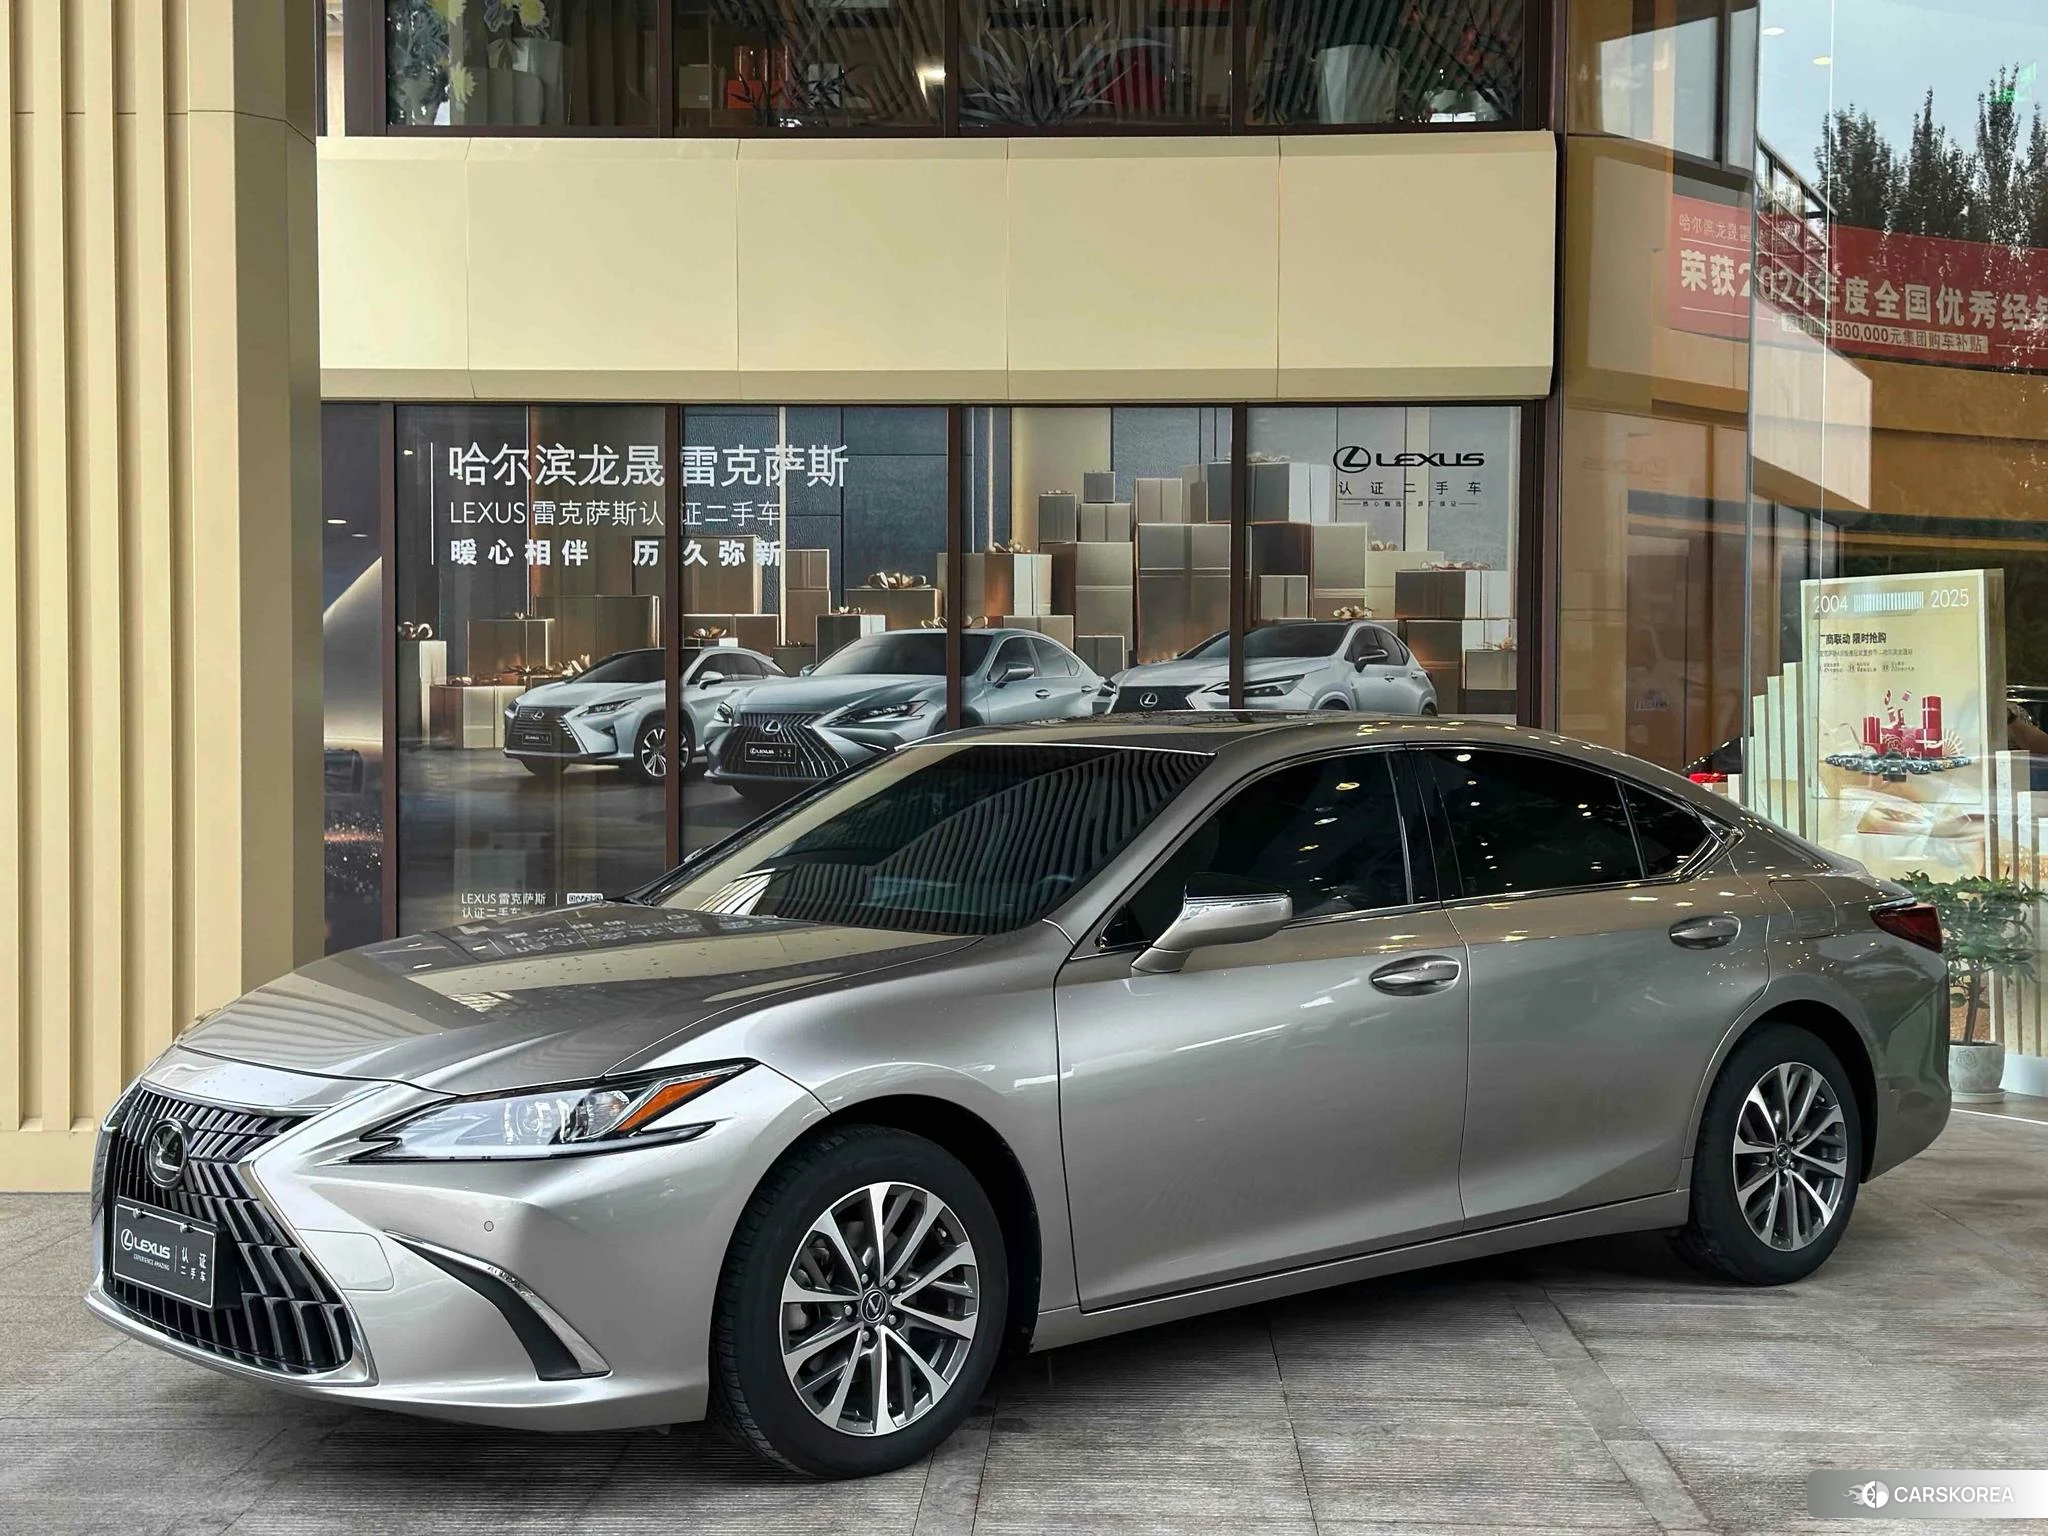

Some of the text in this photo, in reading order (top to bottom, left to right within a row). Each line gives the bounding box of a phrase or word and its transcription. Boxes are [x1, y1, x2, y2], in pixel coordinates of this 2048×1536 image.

[1376, 453, 1485, 467] LEXUS
[1338, 481, 1482, 496] 认证二手车
[450, 502, 526, 524] LEXUS
[1931, 588, 1969, 608] 2025
[461, 893, 497, 904] LEXUS
[134, 1236, 170, 1260] LEXUS
